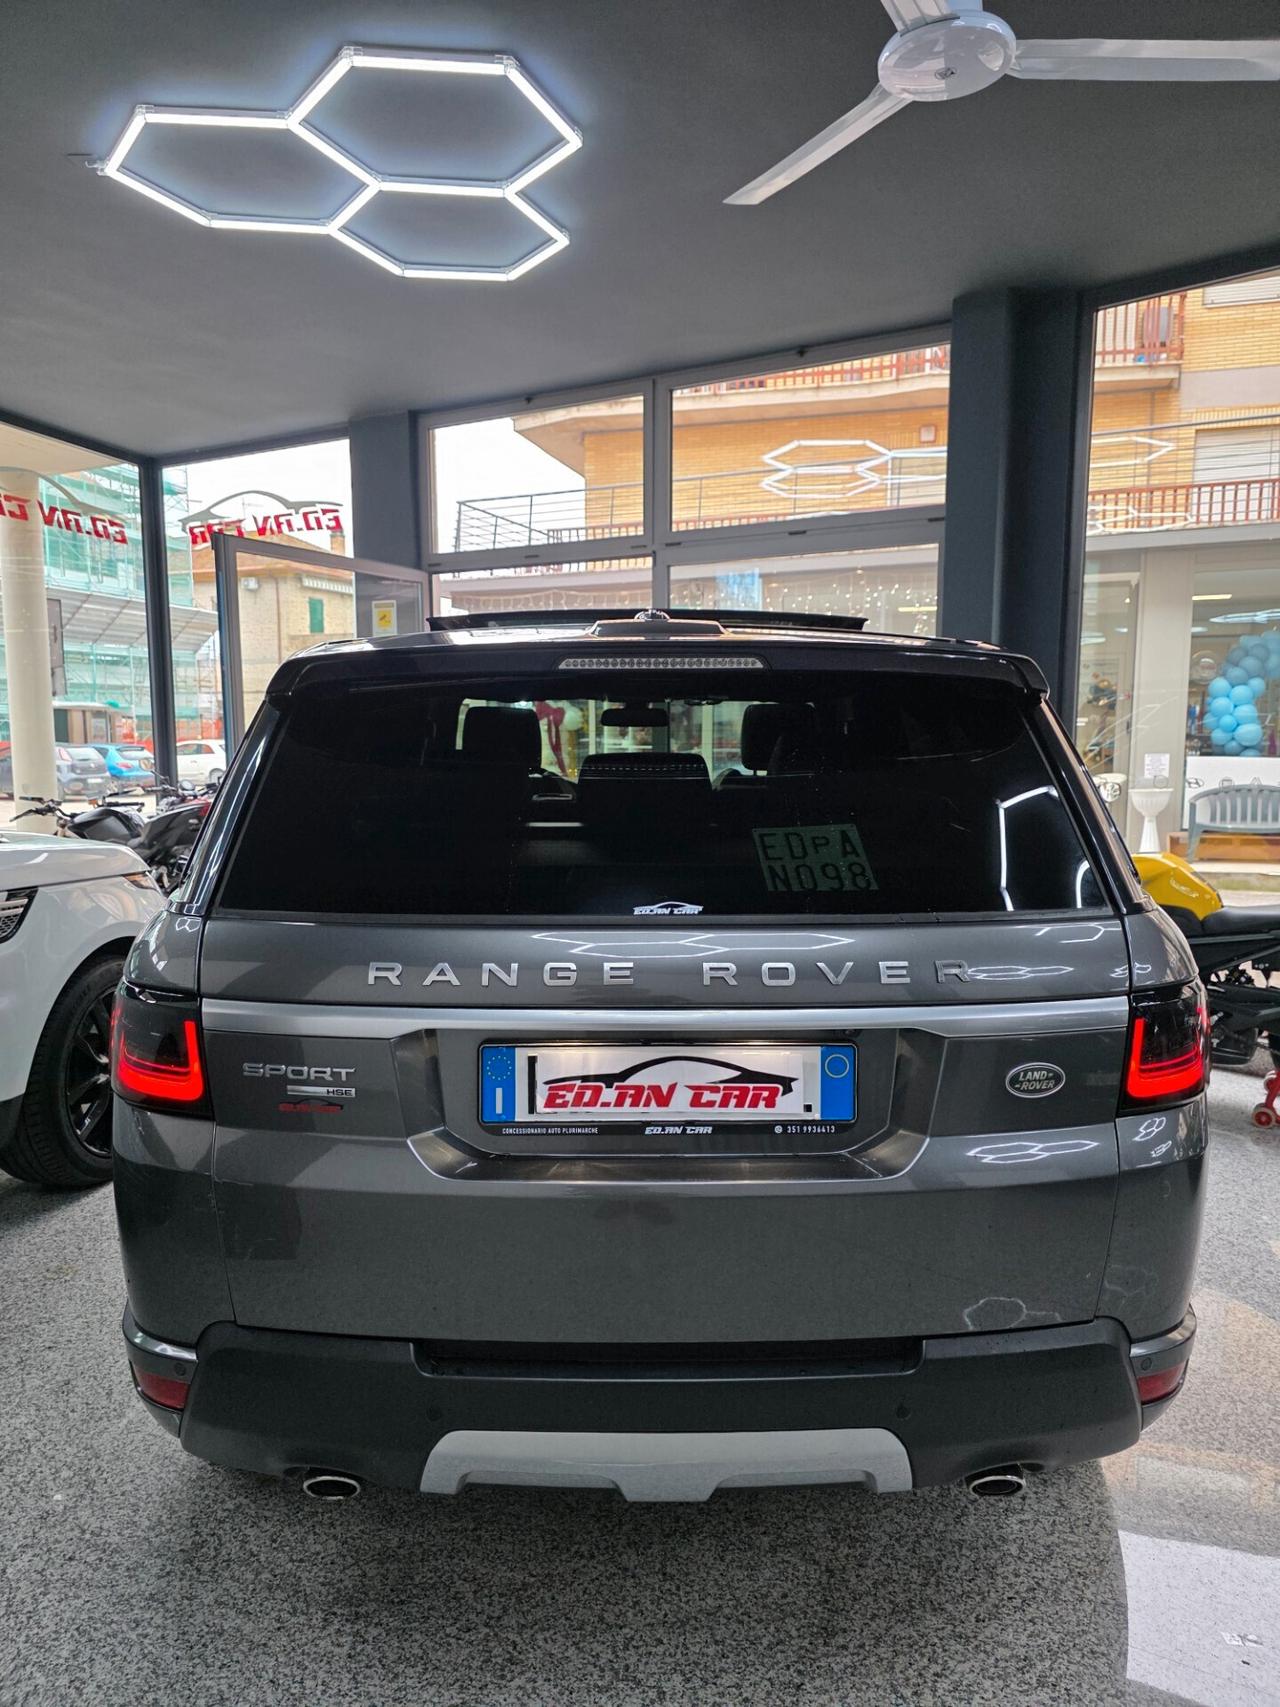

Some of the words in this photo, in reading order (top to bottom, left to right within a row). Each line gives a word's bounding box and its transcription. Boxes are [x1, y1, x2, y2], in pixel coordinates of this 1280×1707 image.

[367, 961, 634, 987] RANGE
[703, 960, 971, 986] ROVER
[242, 1062, 356, 1081] SPORT
[326, 1088, 353, 1097] HSE
[542, 1081, 678, 1109] ED.AN
[683, 1084, 782, 1110] CAR
[502, 1127, 547, 1135] CONCESSIONARIO
[548, 1127, 561, 1135] AUTO
[685, 1126, 713, 1134] CAR
